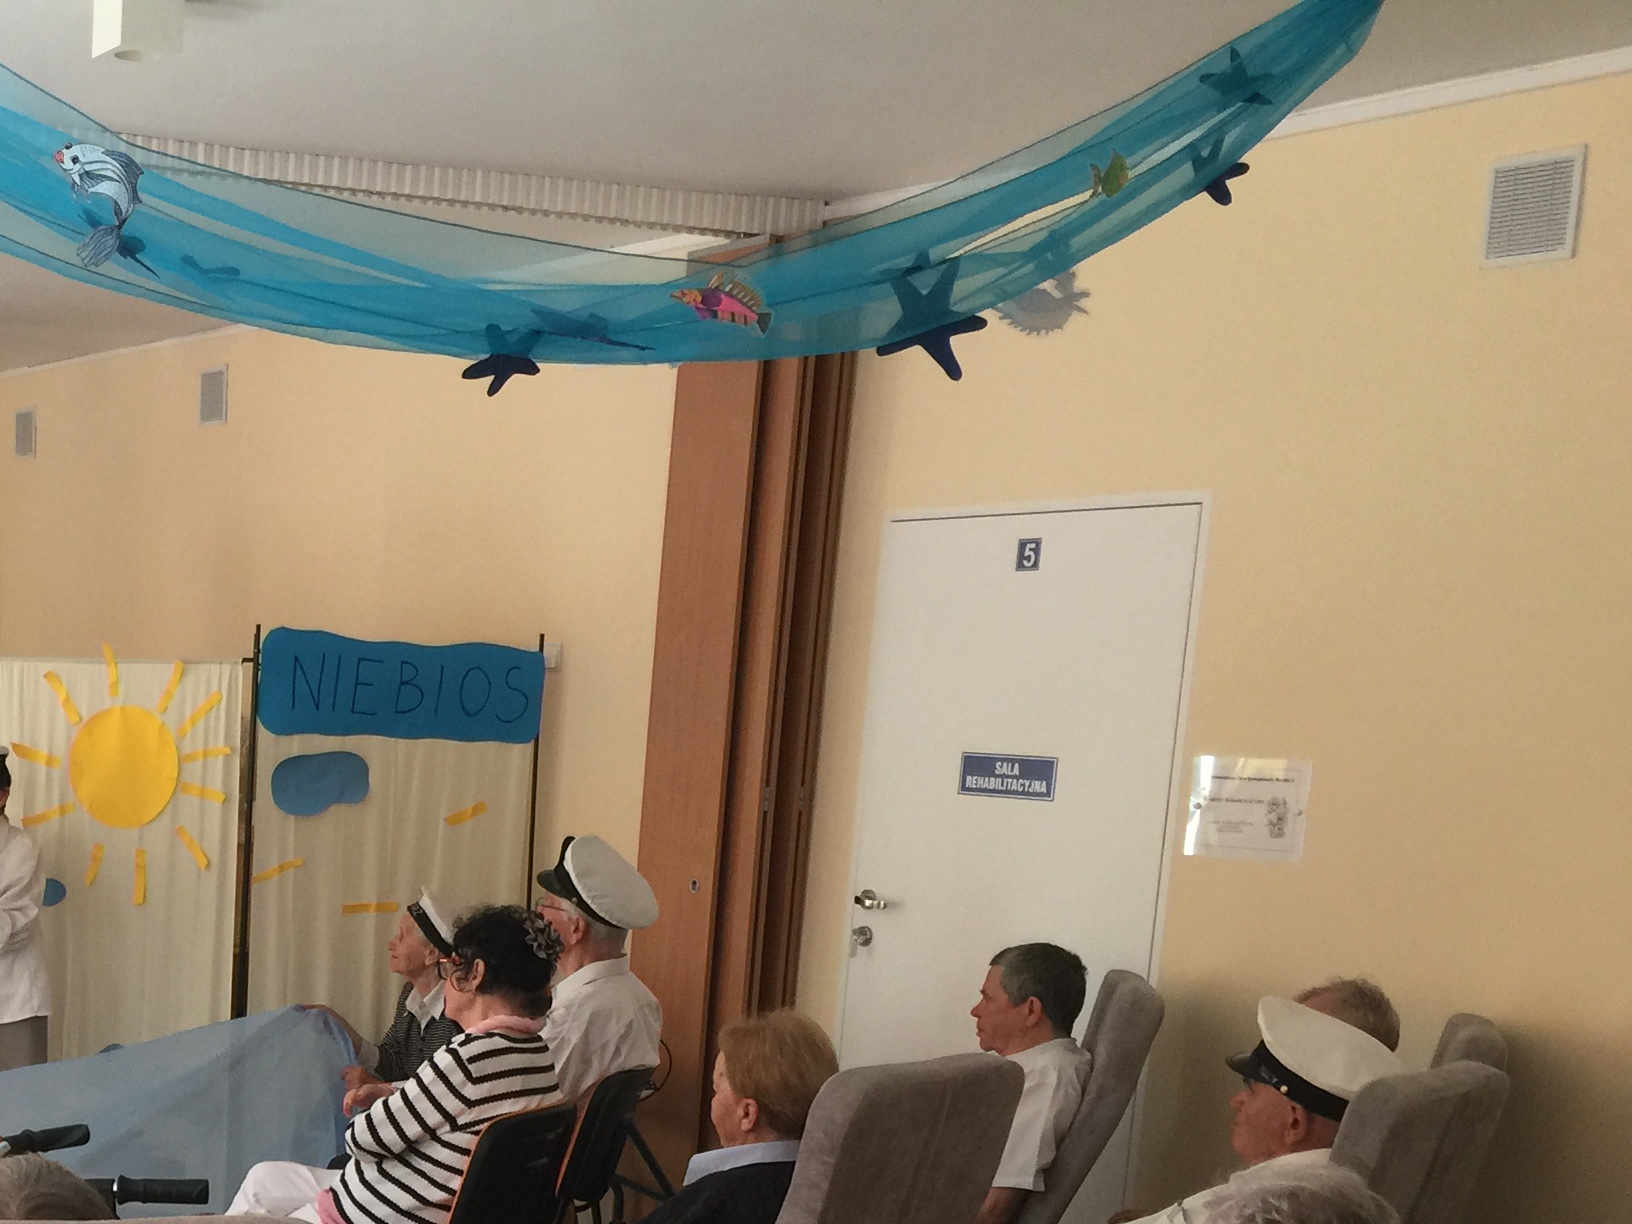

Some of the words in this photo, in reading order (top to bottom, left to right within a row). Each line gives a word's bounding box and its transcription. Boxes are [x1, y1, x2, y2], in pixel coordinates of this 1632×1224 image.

[1023, 543, 1036, 567] 5
[291, 652, 529, 724] NIEBIOS
[994, 761, 1020, 776] SALA
[965, 775, 1047, 793] REHABILITACYJNA
